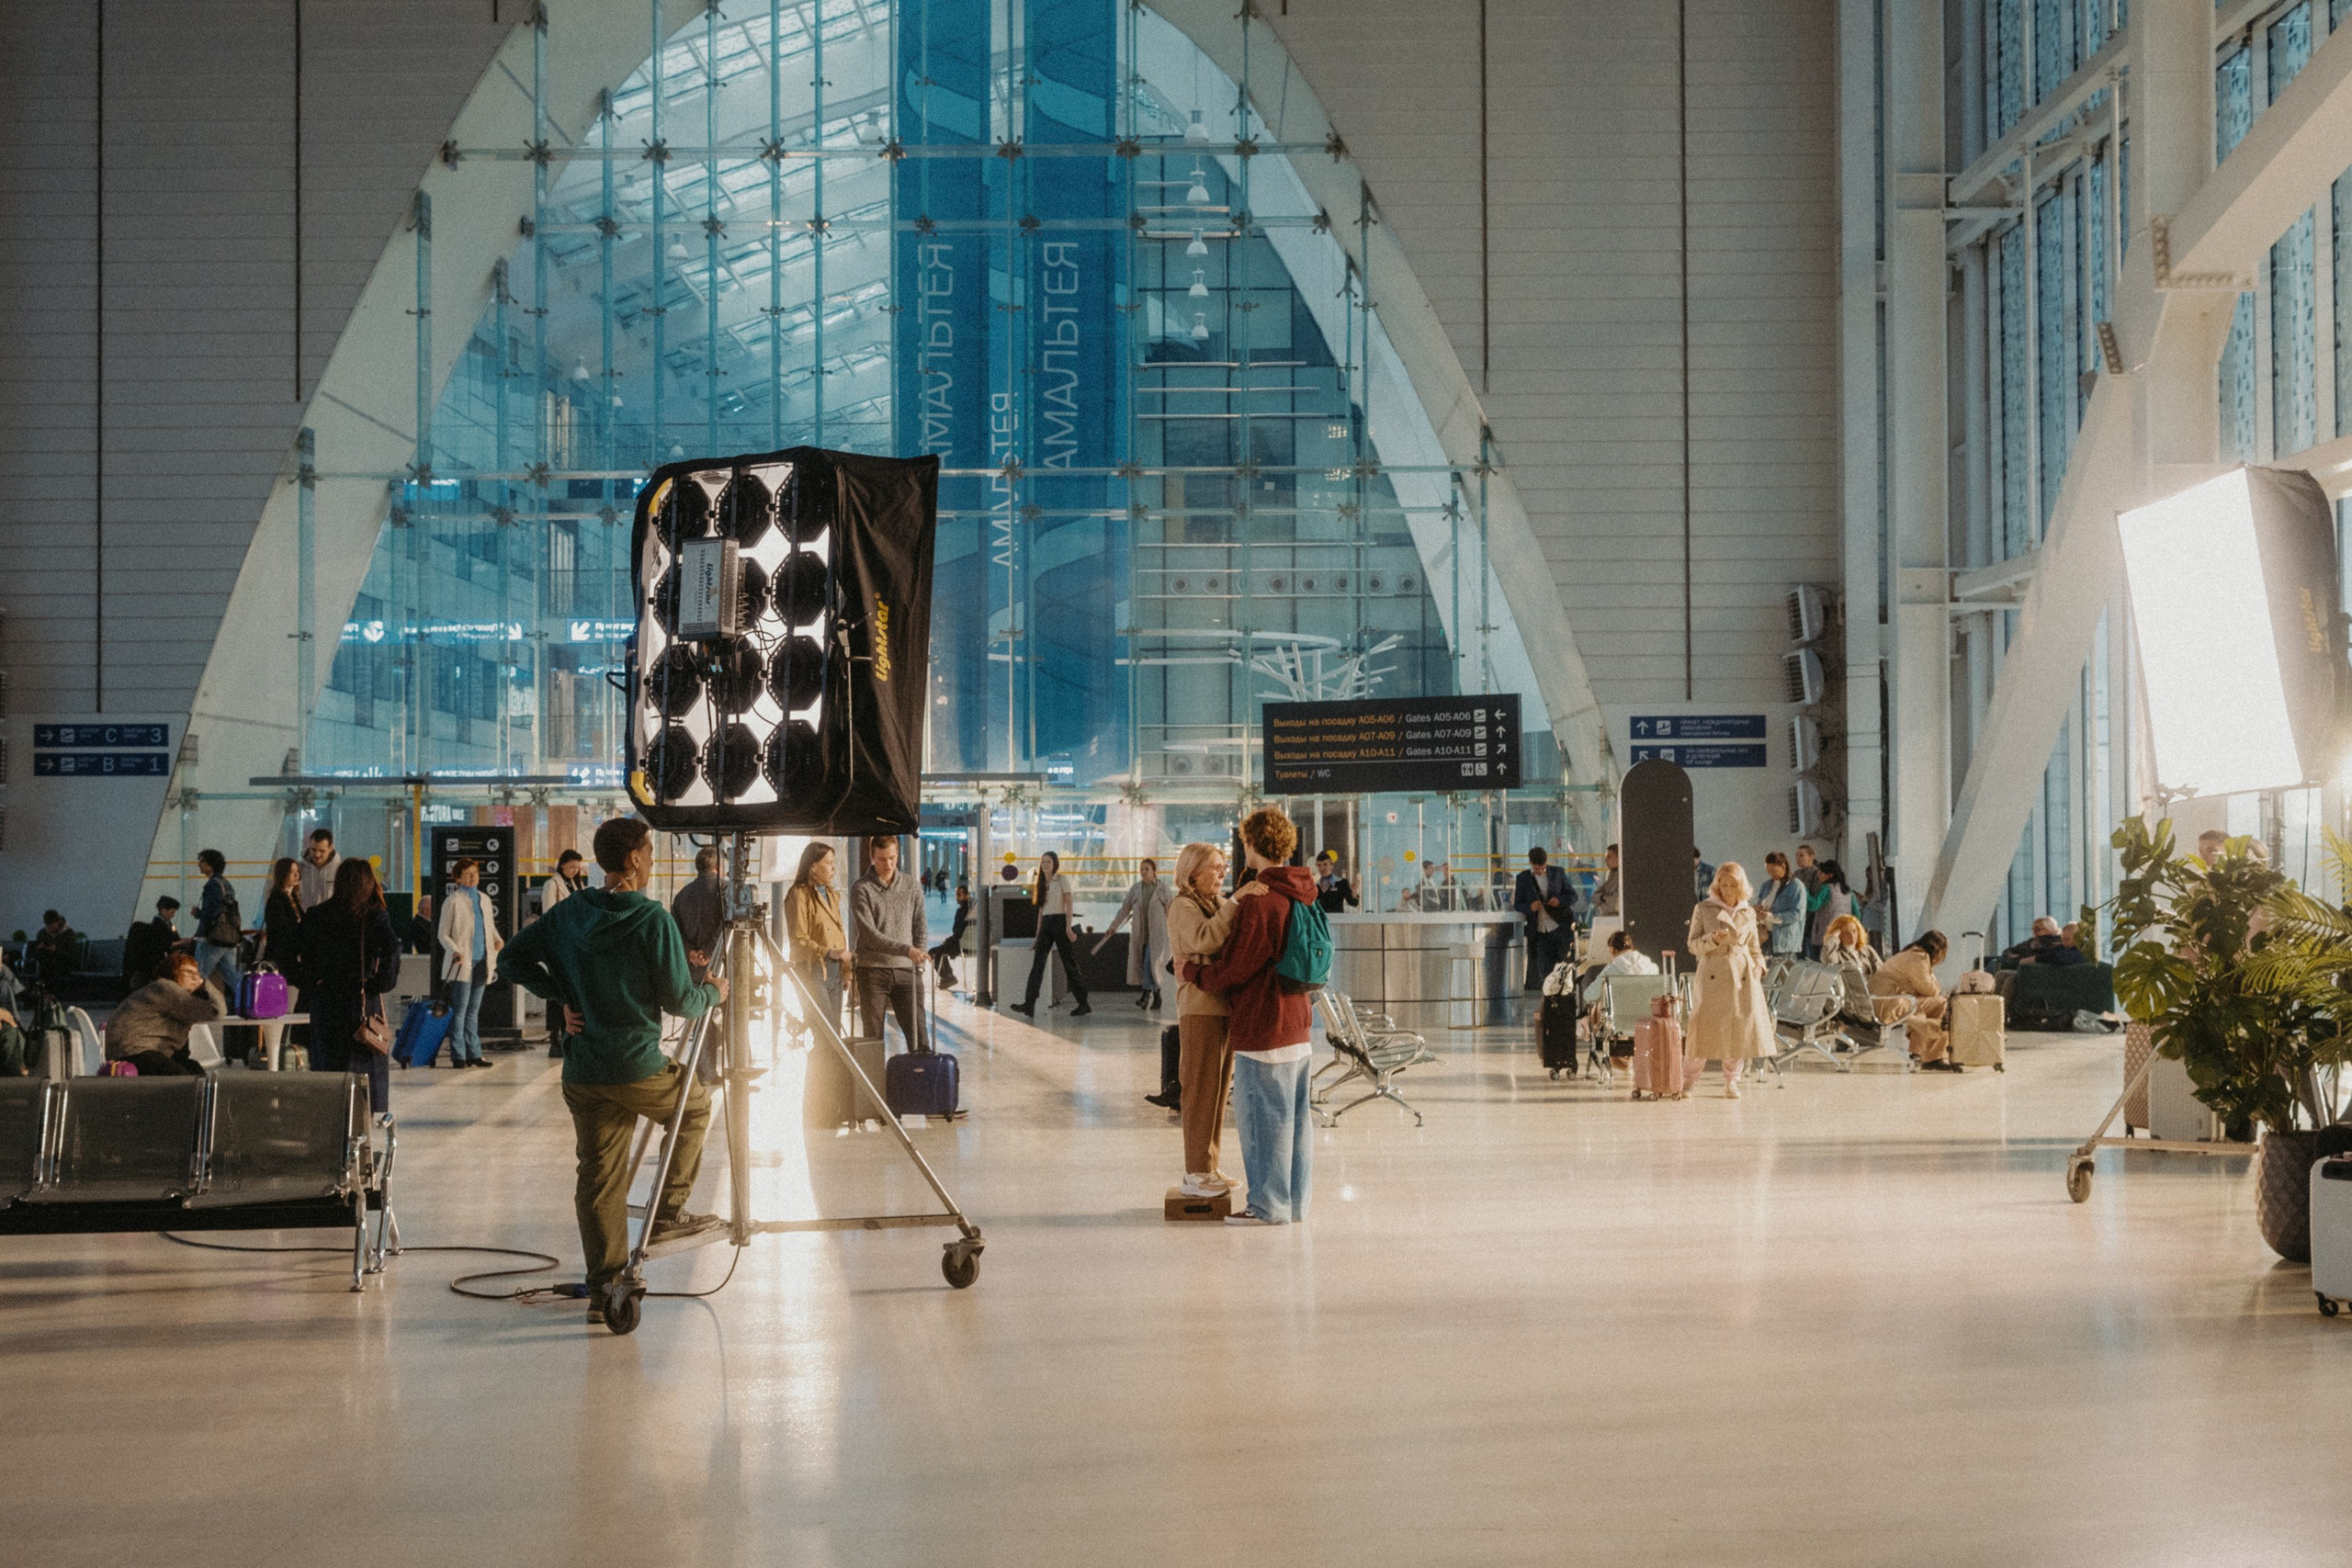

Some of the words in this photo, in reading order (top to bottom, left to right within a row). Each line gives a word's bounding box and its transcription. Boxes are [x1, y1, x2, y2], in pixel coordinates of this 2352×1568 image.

[1043, 242, 1079, 469] АМАЛЬТЕЯ
[875, 600, 892, 682] lightstar
[1273, 718, 1306, 728] Выходы
[1308, 718, 1319, 727] на
[1321, 717, 1356, 727] посадку
[1359, 715, 1395, 724] A05-A06
[1405, 714, 1431, 723] Gates
[1433, 712, 1471, 722] A05-A06
[105, 728, 117, 743] C
[151, 728, 162, 743] 3
[1273, 735, 1306, 744] Выходы
[1322, 734, 1357, 743] посадку
[1359, 731, 1396, 740] A07-A09
[1406, 730, 1431, 739] Gates
[1434, 728, 1472, 739] A07-A09
[1274, 750, 1307, 760] Выходы
[1322, 750, 1357, 760] посадку
[1359, 748, 1396, 757] A10-A11
[1406, 747, 1432, 756] Gates
[1434, 746, 1472, 755] A10-A11
[103, 757, 115, 773] B
[150, 757, 161, 772] 1
[1275, 770, 1307, 780] Туалеты
[1317, 769, 1331, 778] WC
